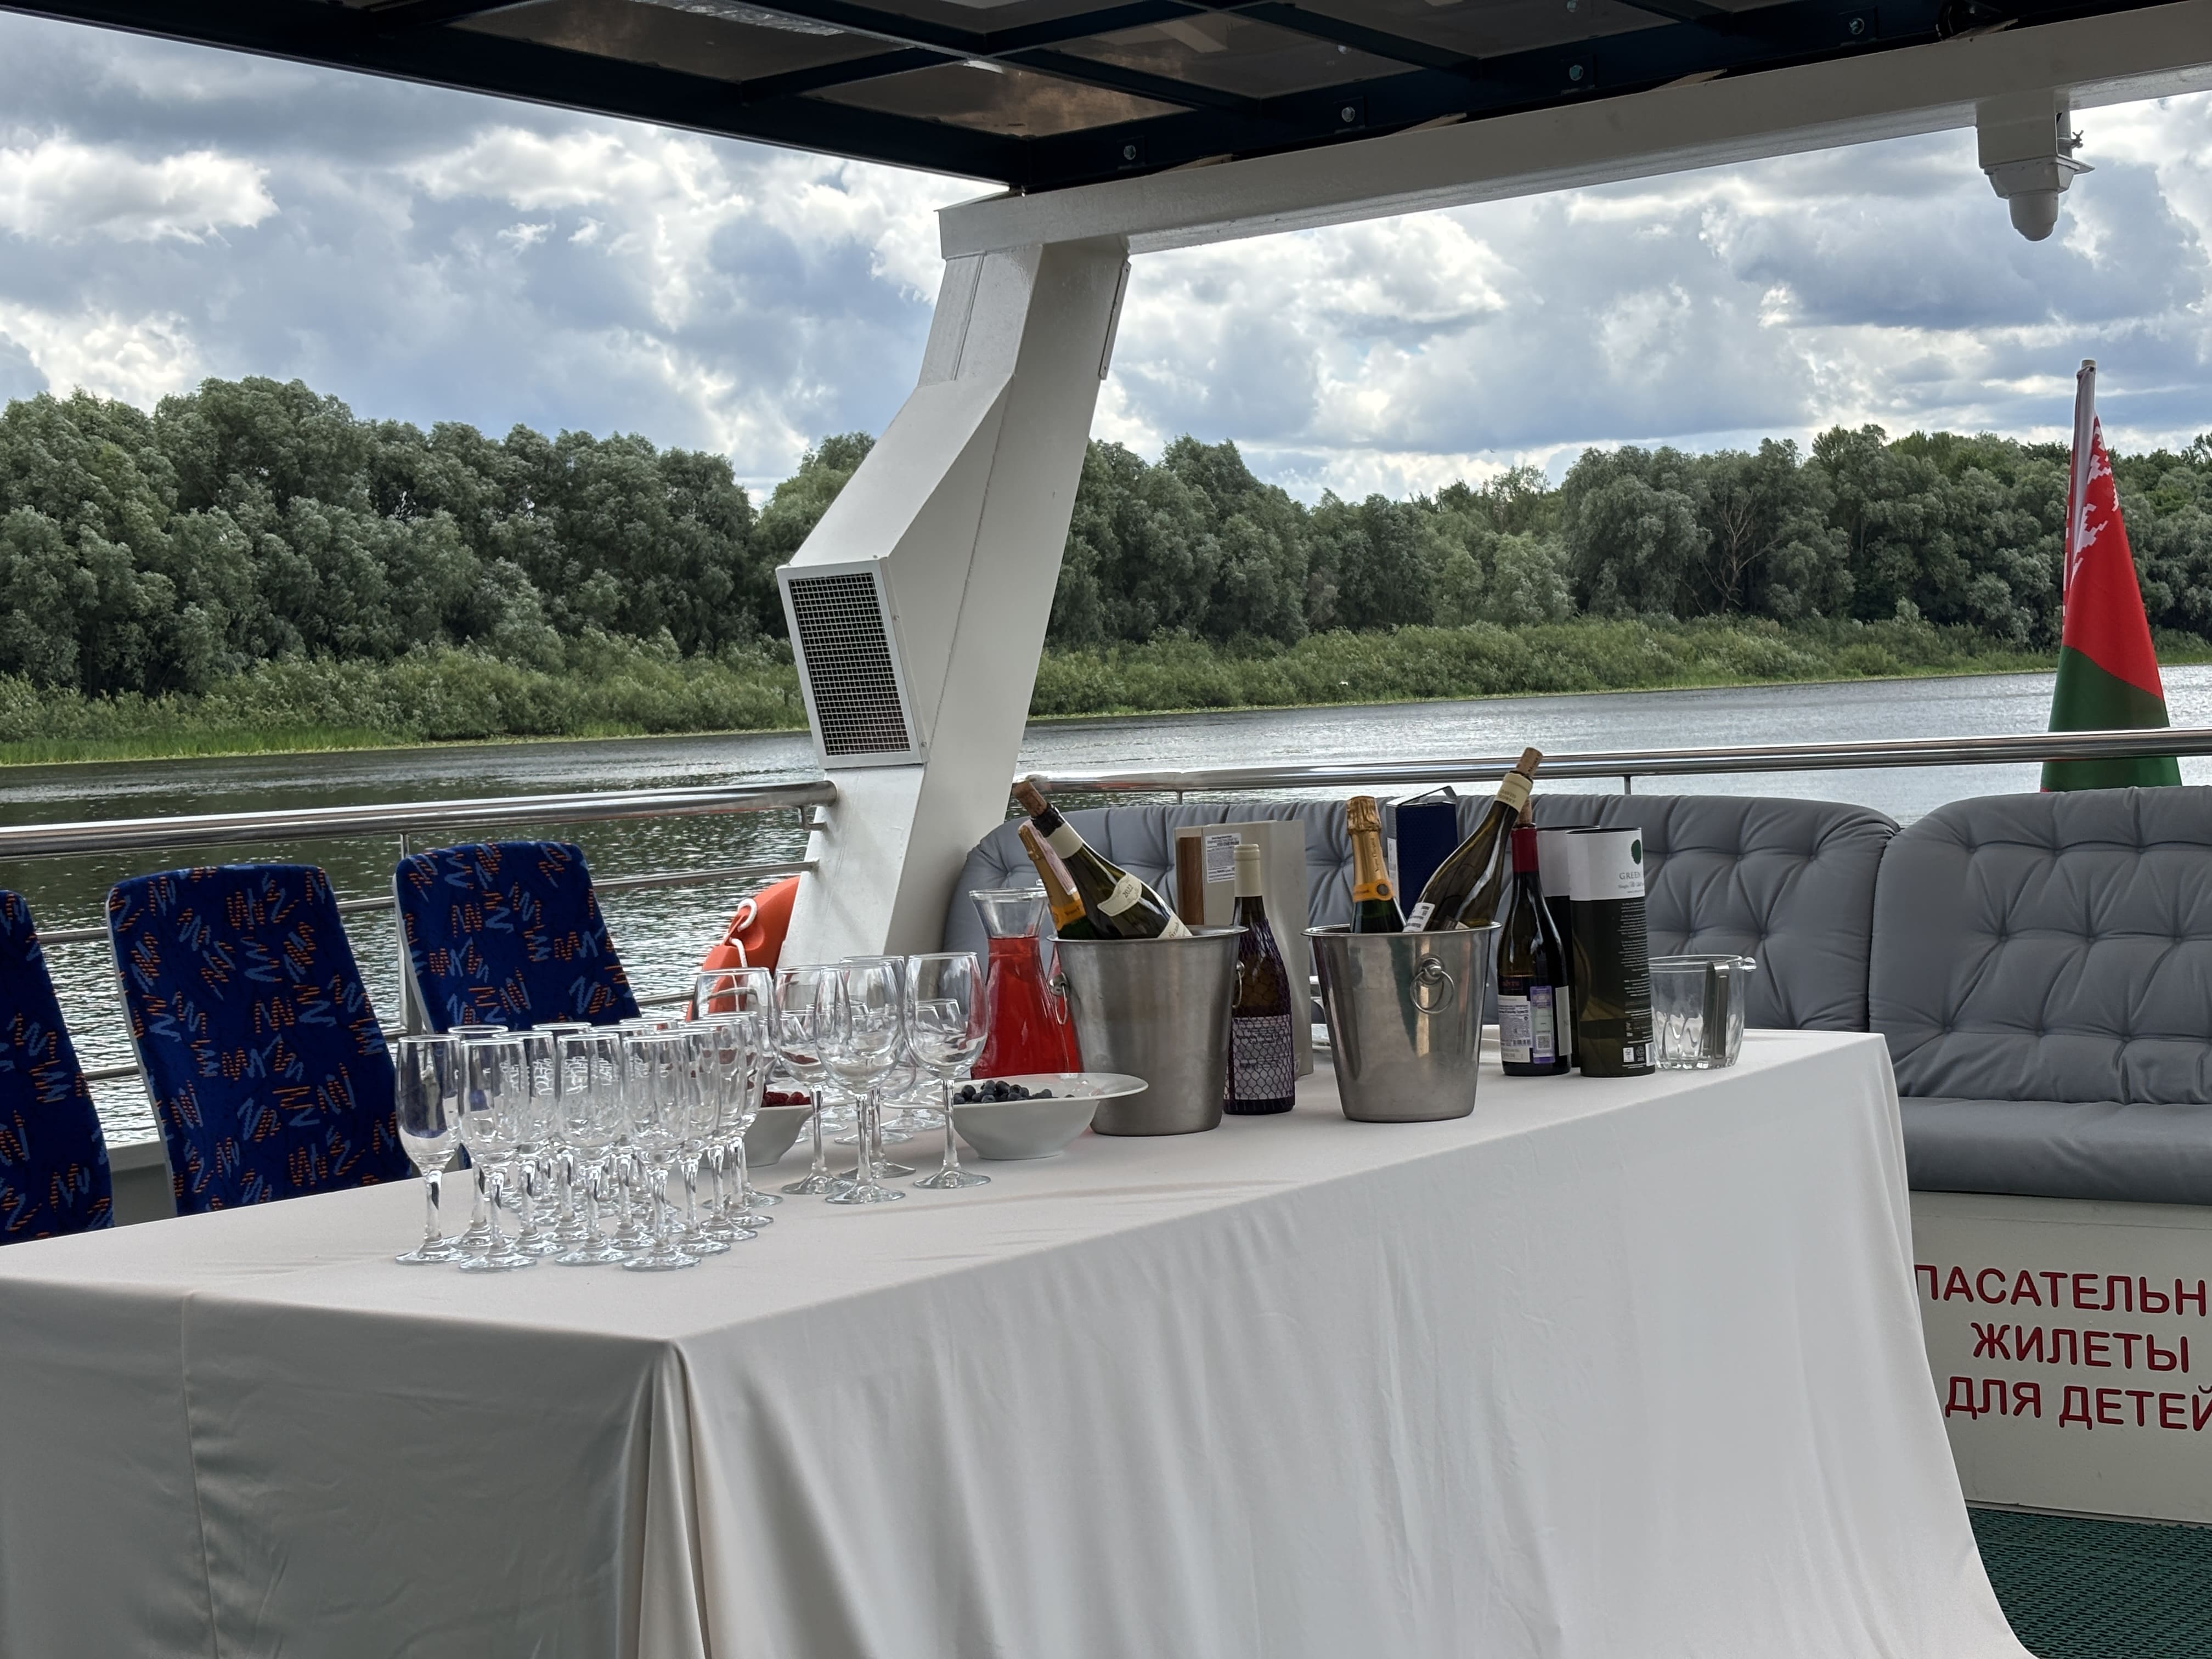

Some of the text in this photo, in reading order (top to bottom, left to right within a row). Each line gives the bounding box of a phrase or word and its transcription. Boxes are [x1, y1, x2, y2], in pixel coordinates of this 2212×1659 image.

[1122, 884, 1134, 899] 2022
[1970, 1322, 2189, 1373] ЖИЛЕТЫ
[1945, 1376, 2212, 1431] ДЛЯ ДЕТЕЙ
